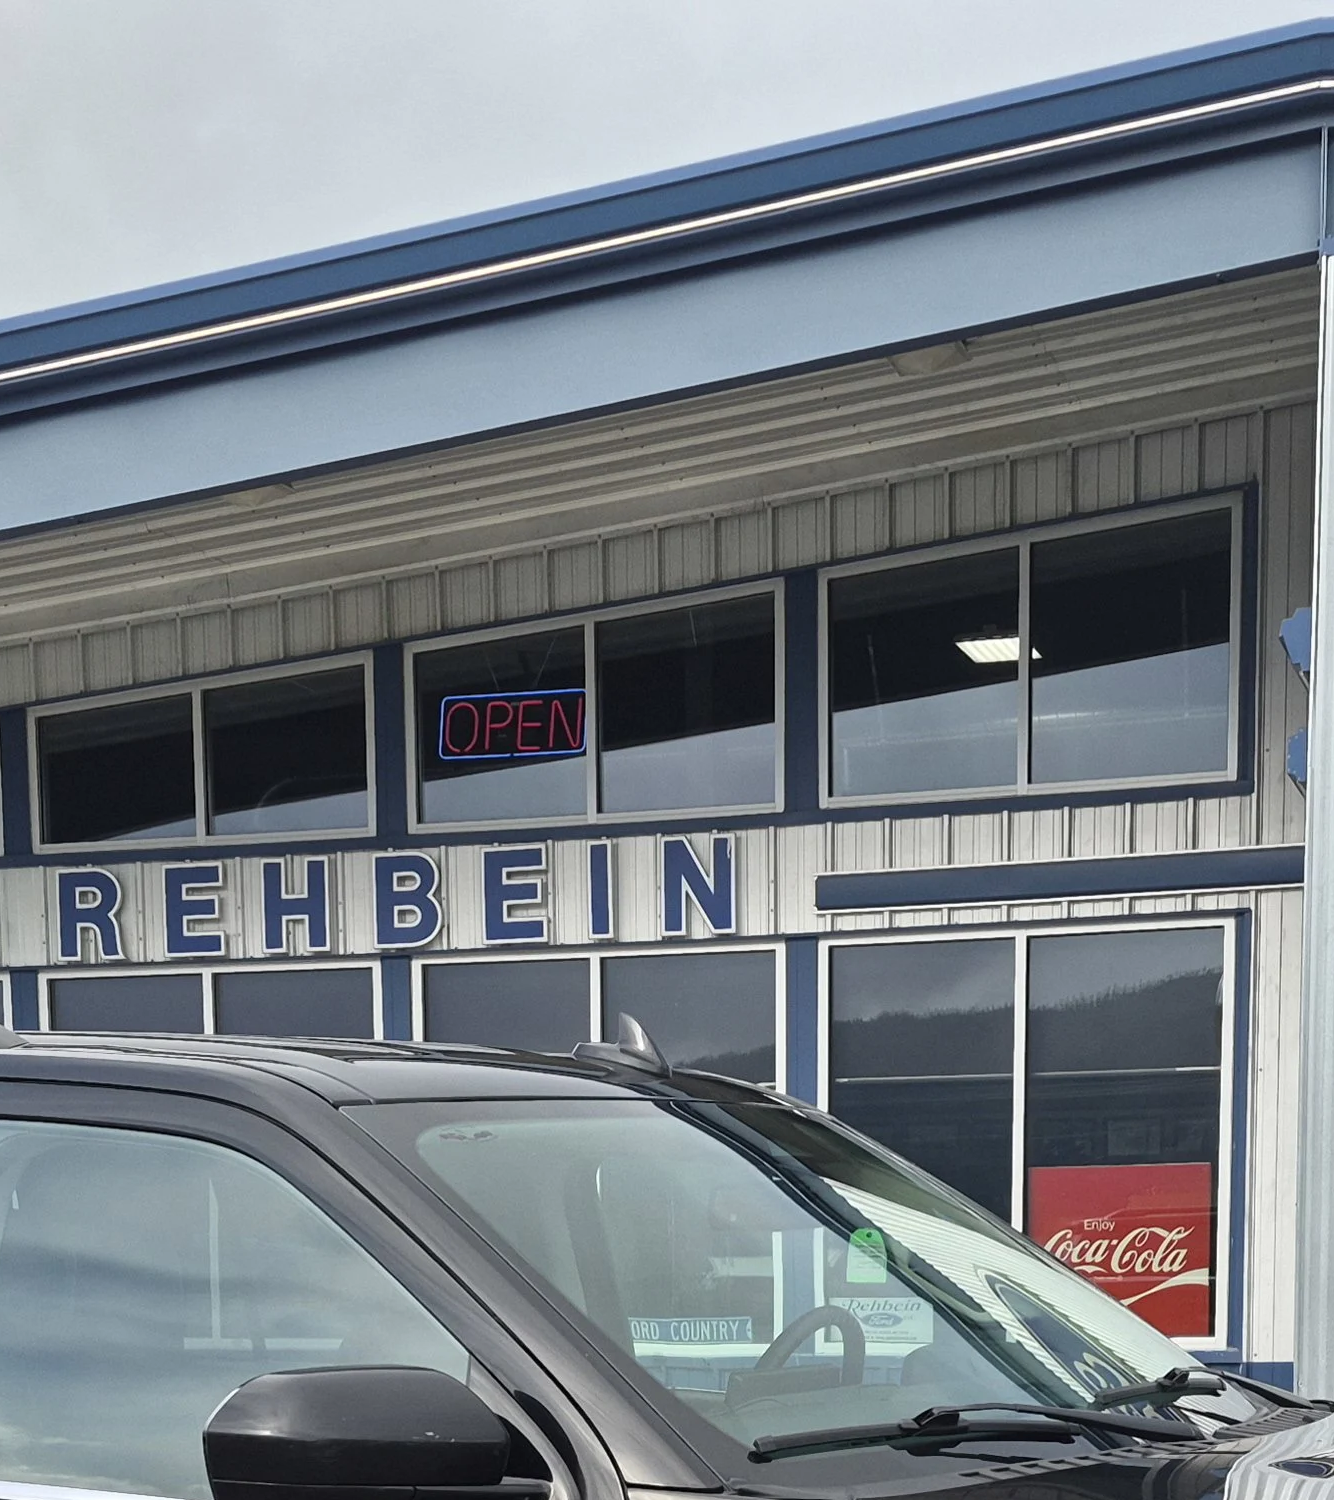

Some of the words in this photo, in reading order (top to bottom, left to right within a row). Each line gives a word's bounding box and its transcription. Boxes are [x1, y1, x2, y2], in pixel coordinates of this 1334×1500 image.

[445, 697, 583, 753] OPEN
[56, 832, 738, 963] REHBEIN
[1083, 1218, 1115, 1232] Enjoy
[842, 1298, 921, 1314] Rehbein
[630, 1320, 659, 1340] ORD
[670, 1319, 740, 1341] COUNTRY
